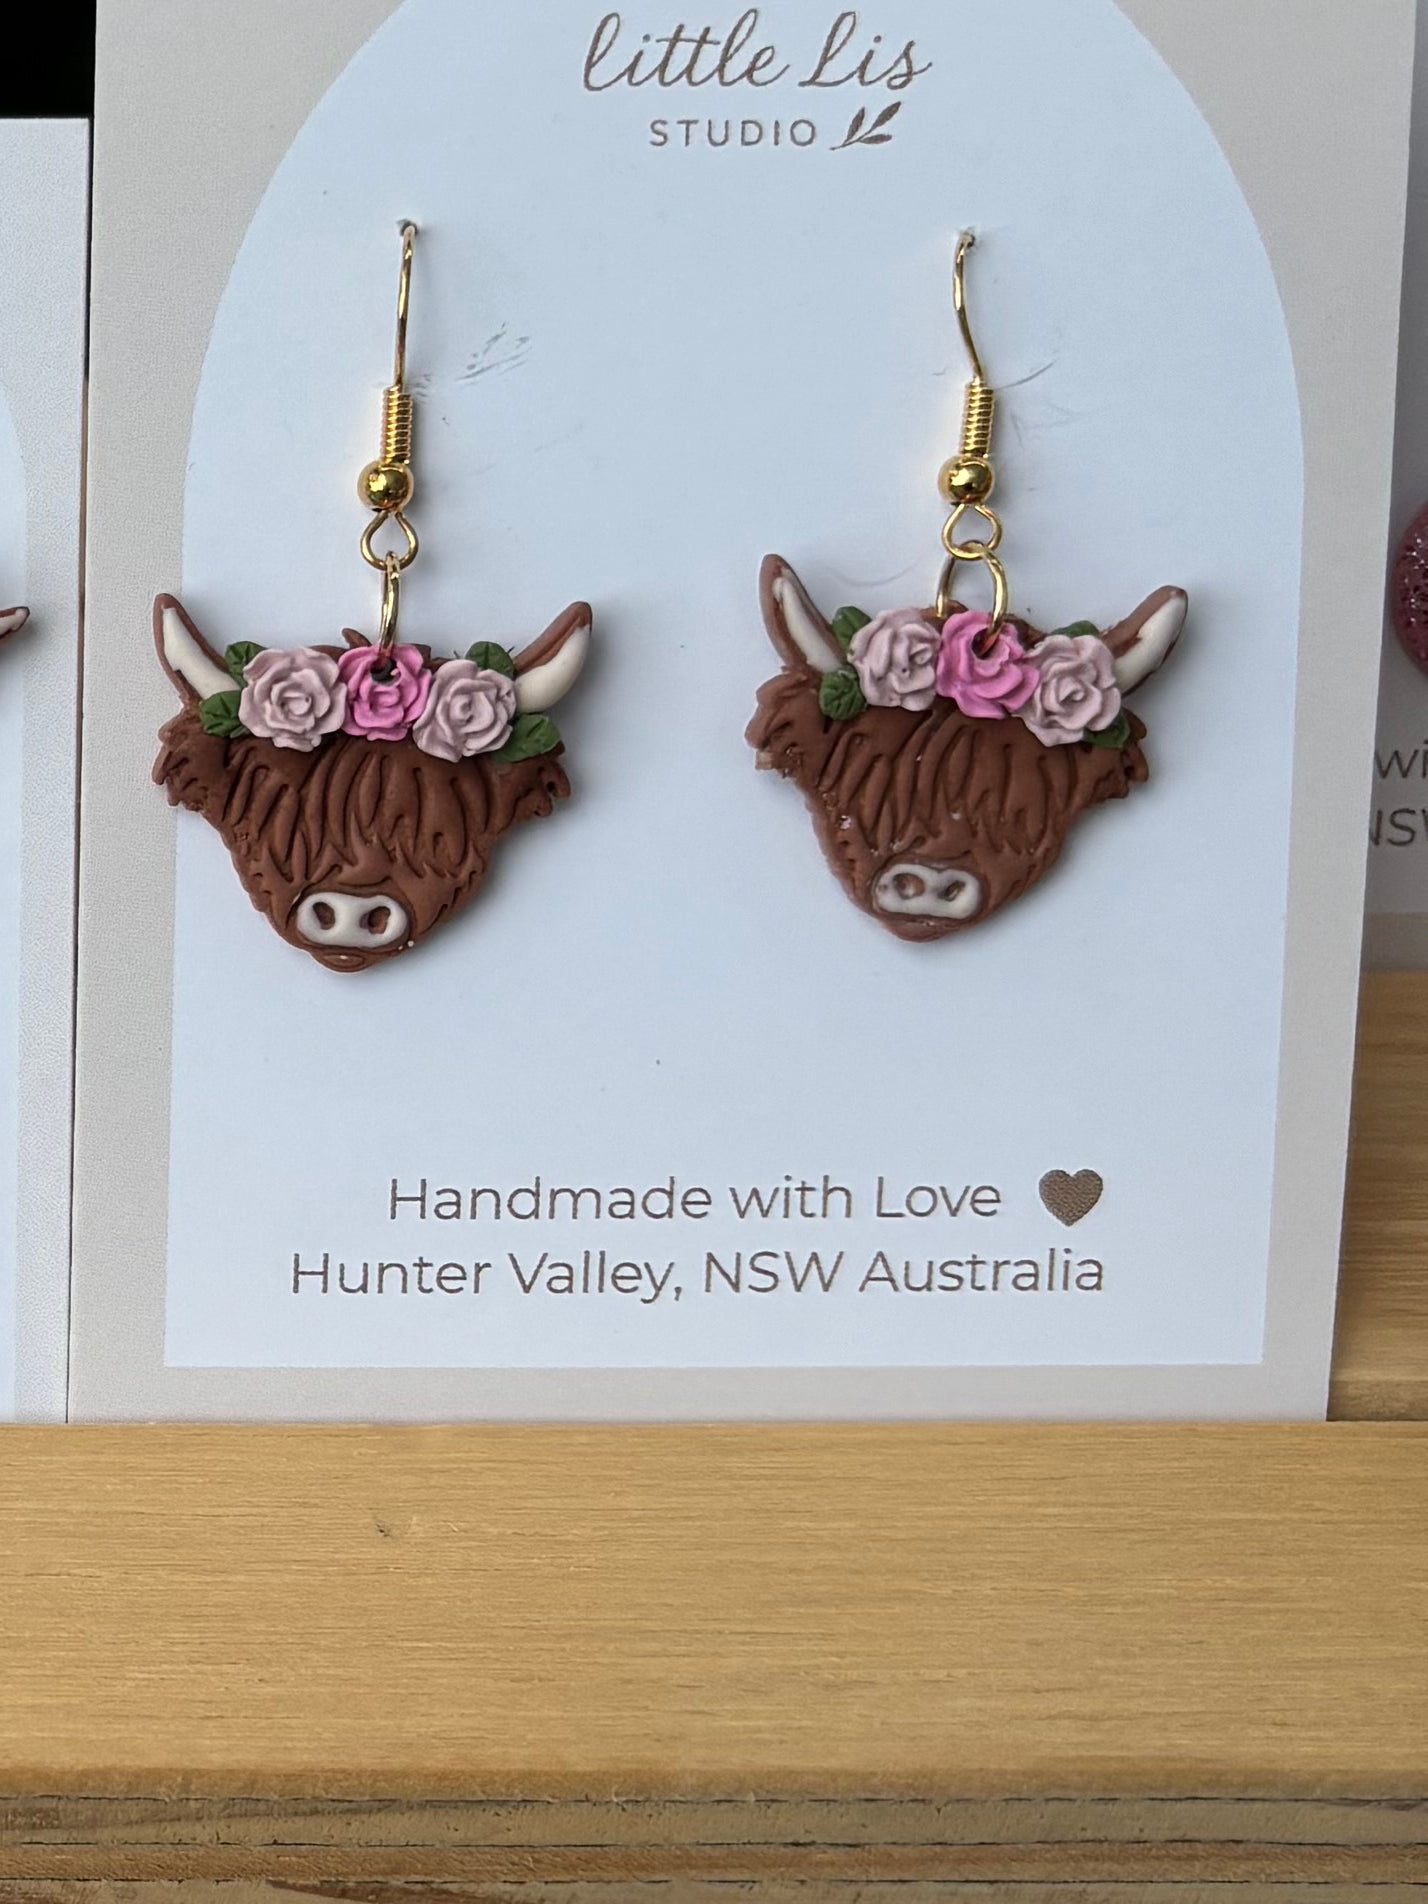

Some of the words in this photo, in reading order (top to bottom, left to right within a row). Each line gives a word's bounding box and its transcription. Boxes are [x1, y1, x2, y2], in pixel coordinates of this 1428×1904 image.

[583, 8, 791, 92] little
[797, 10, 933, 91] Lis
[649, 118, 817, 148] STUDIO
[390, 1175, 713, 1221] Handmade
[728, 1174, 853, 1220] with
[876, 1176, 1002, 1218] Love
[292, 1252, 493, 1295] Hunter
[507, 1249, 683, 1305] Valley,
[704, 1250, 845, 1294] NSW
[858, 1247, 1104, 1293] Australia
